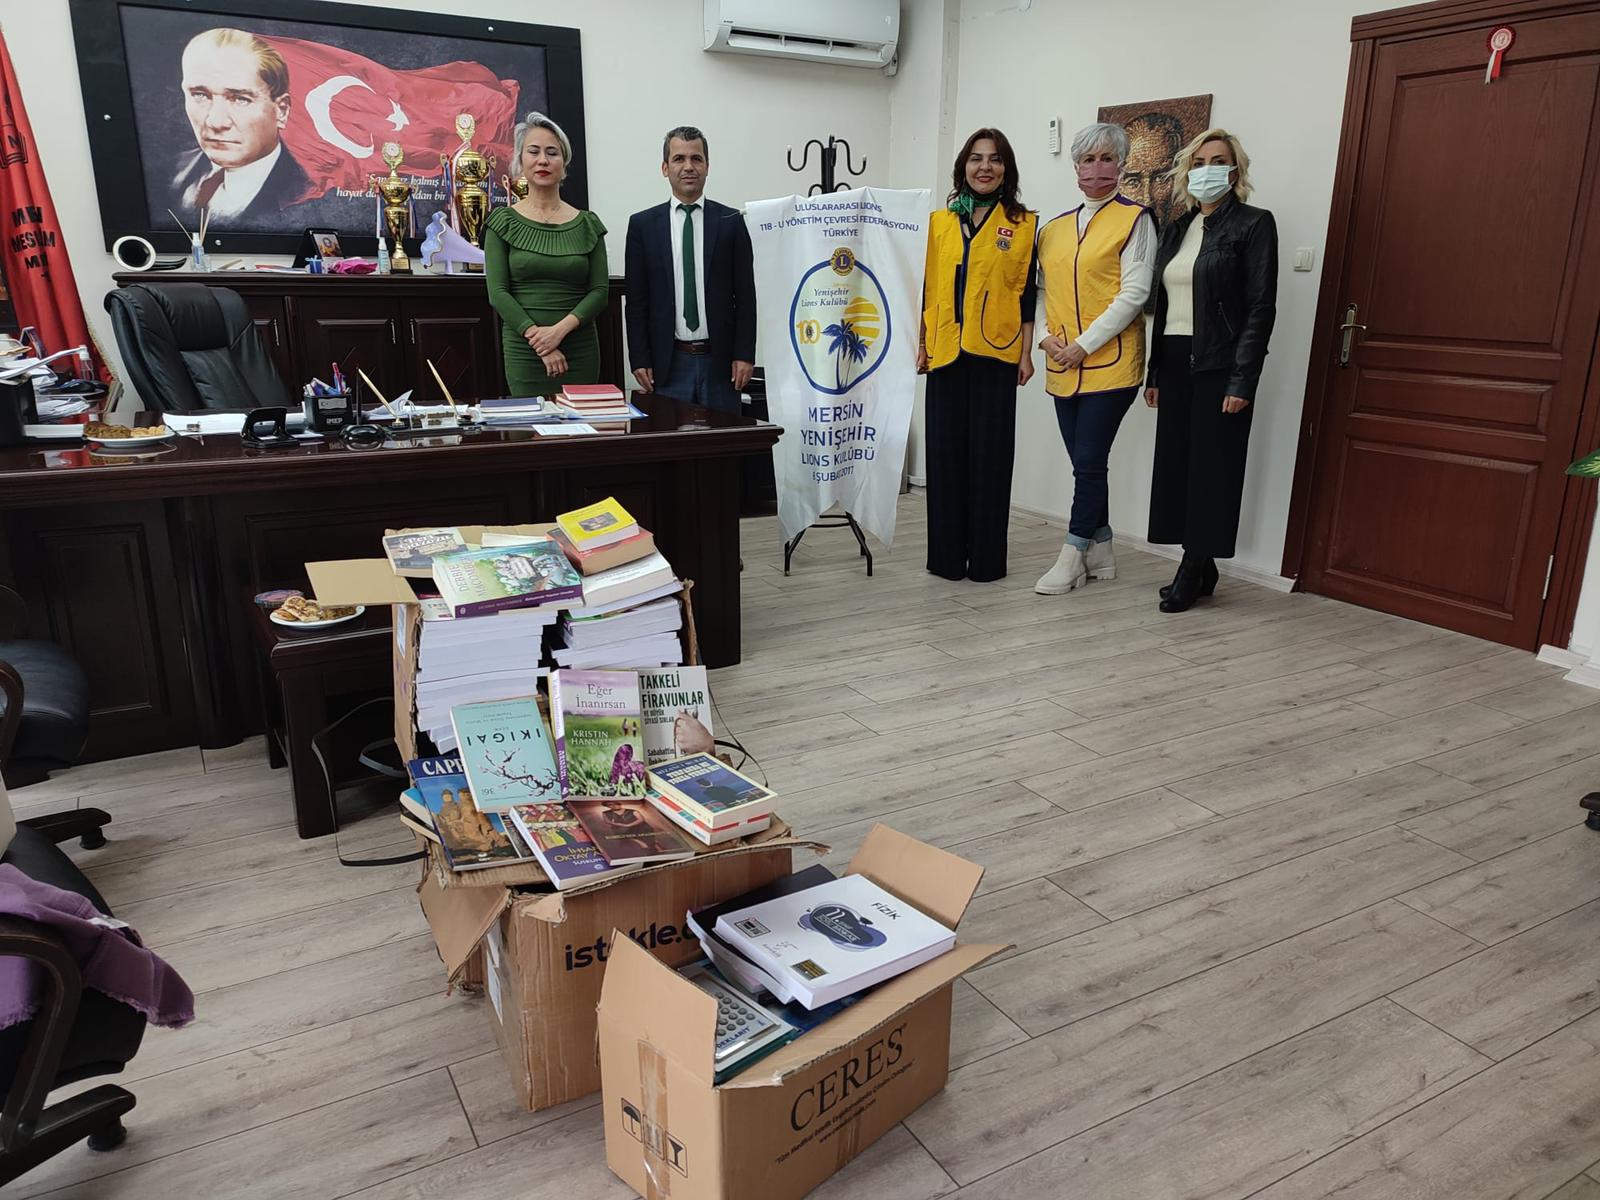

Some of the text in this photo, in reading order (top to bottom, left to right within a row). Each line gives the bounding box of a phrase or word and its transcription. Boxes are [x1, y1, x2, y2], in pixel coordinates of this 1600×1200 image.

[411, 175, 438, 187] kalmış
[336, 186, 363, 201] hayat
[794, 201, 882, 213] ULUSLARARASI LIONS
[760, 223, 773, 232] 118
[778, 221, 785, 229] U
[785, 214, 822, 226] YÖNETİM
[824, 213, 859, 226] ÇEVRESİ
[859, 215, 919, 232] FEDERASYONU
[823, 228, 859, 238] TÜRKİYE
[814, 287, 849, 297] Yenişehir
[801, 298, 848, 307] Lions Kulübü
[808, 399, 864, 422] MERSİN
[800, 422, 876, 450] YENİŞEHİR
[801, 446, 875, 467] LIONS KULÜBÜ
[449, 563, 470, 593] DEBBIE
[640, 670, 681, 690] TAKKELİ
[587, 683, 614, 698] Eğer
[576, 696, 626, 709] İnanırsan
[641, 690, 705, 709] FİRAVUNLAR
[466, 728, 541, 746] IKIGAI
[573, 729, 609, 739] KRISTIN
[571, 737, 612, 747] HANNAH
[554, 852, 588, 862] OKTAY
[871, 902, 901, 920] FİZİK
[790, 1027, 903, 1131] CERES
